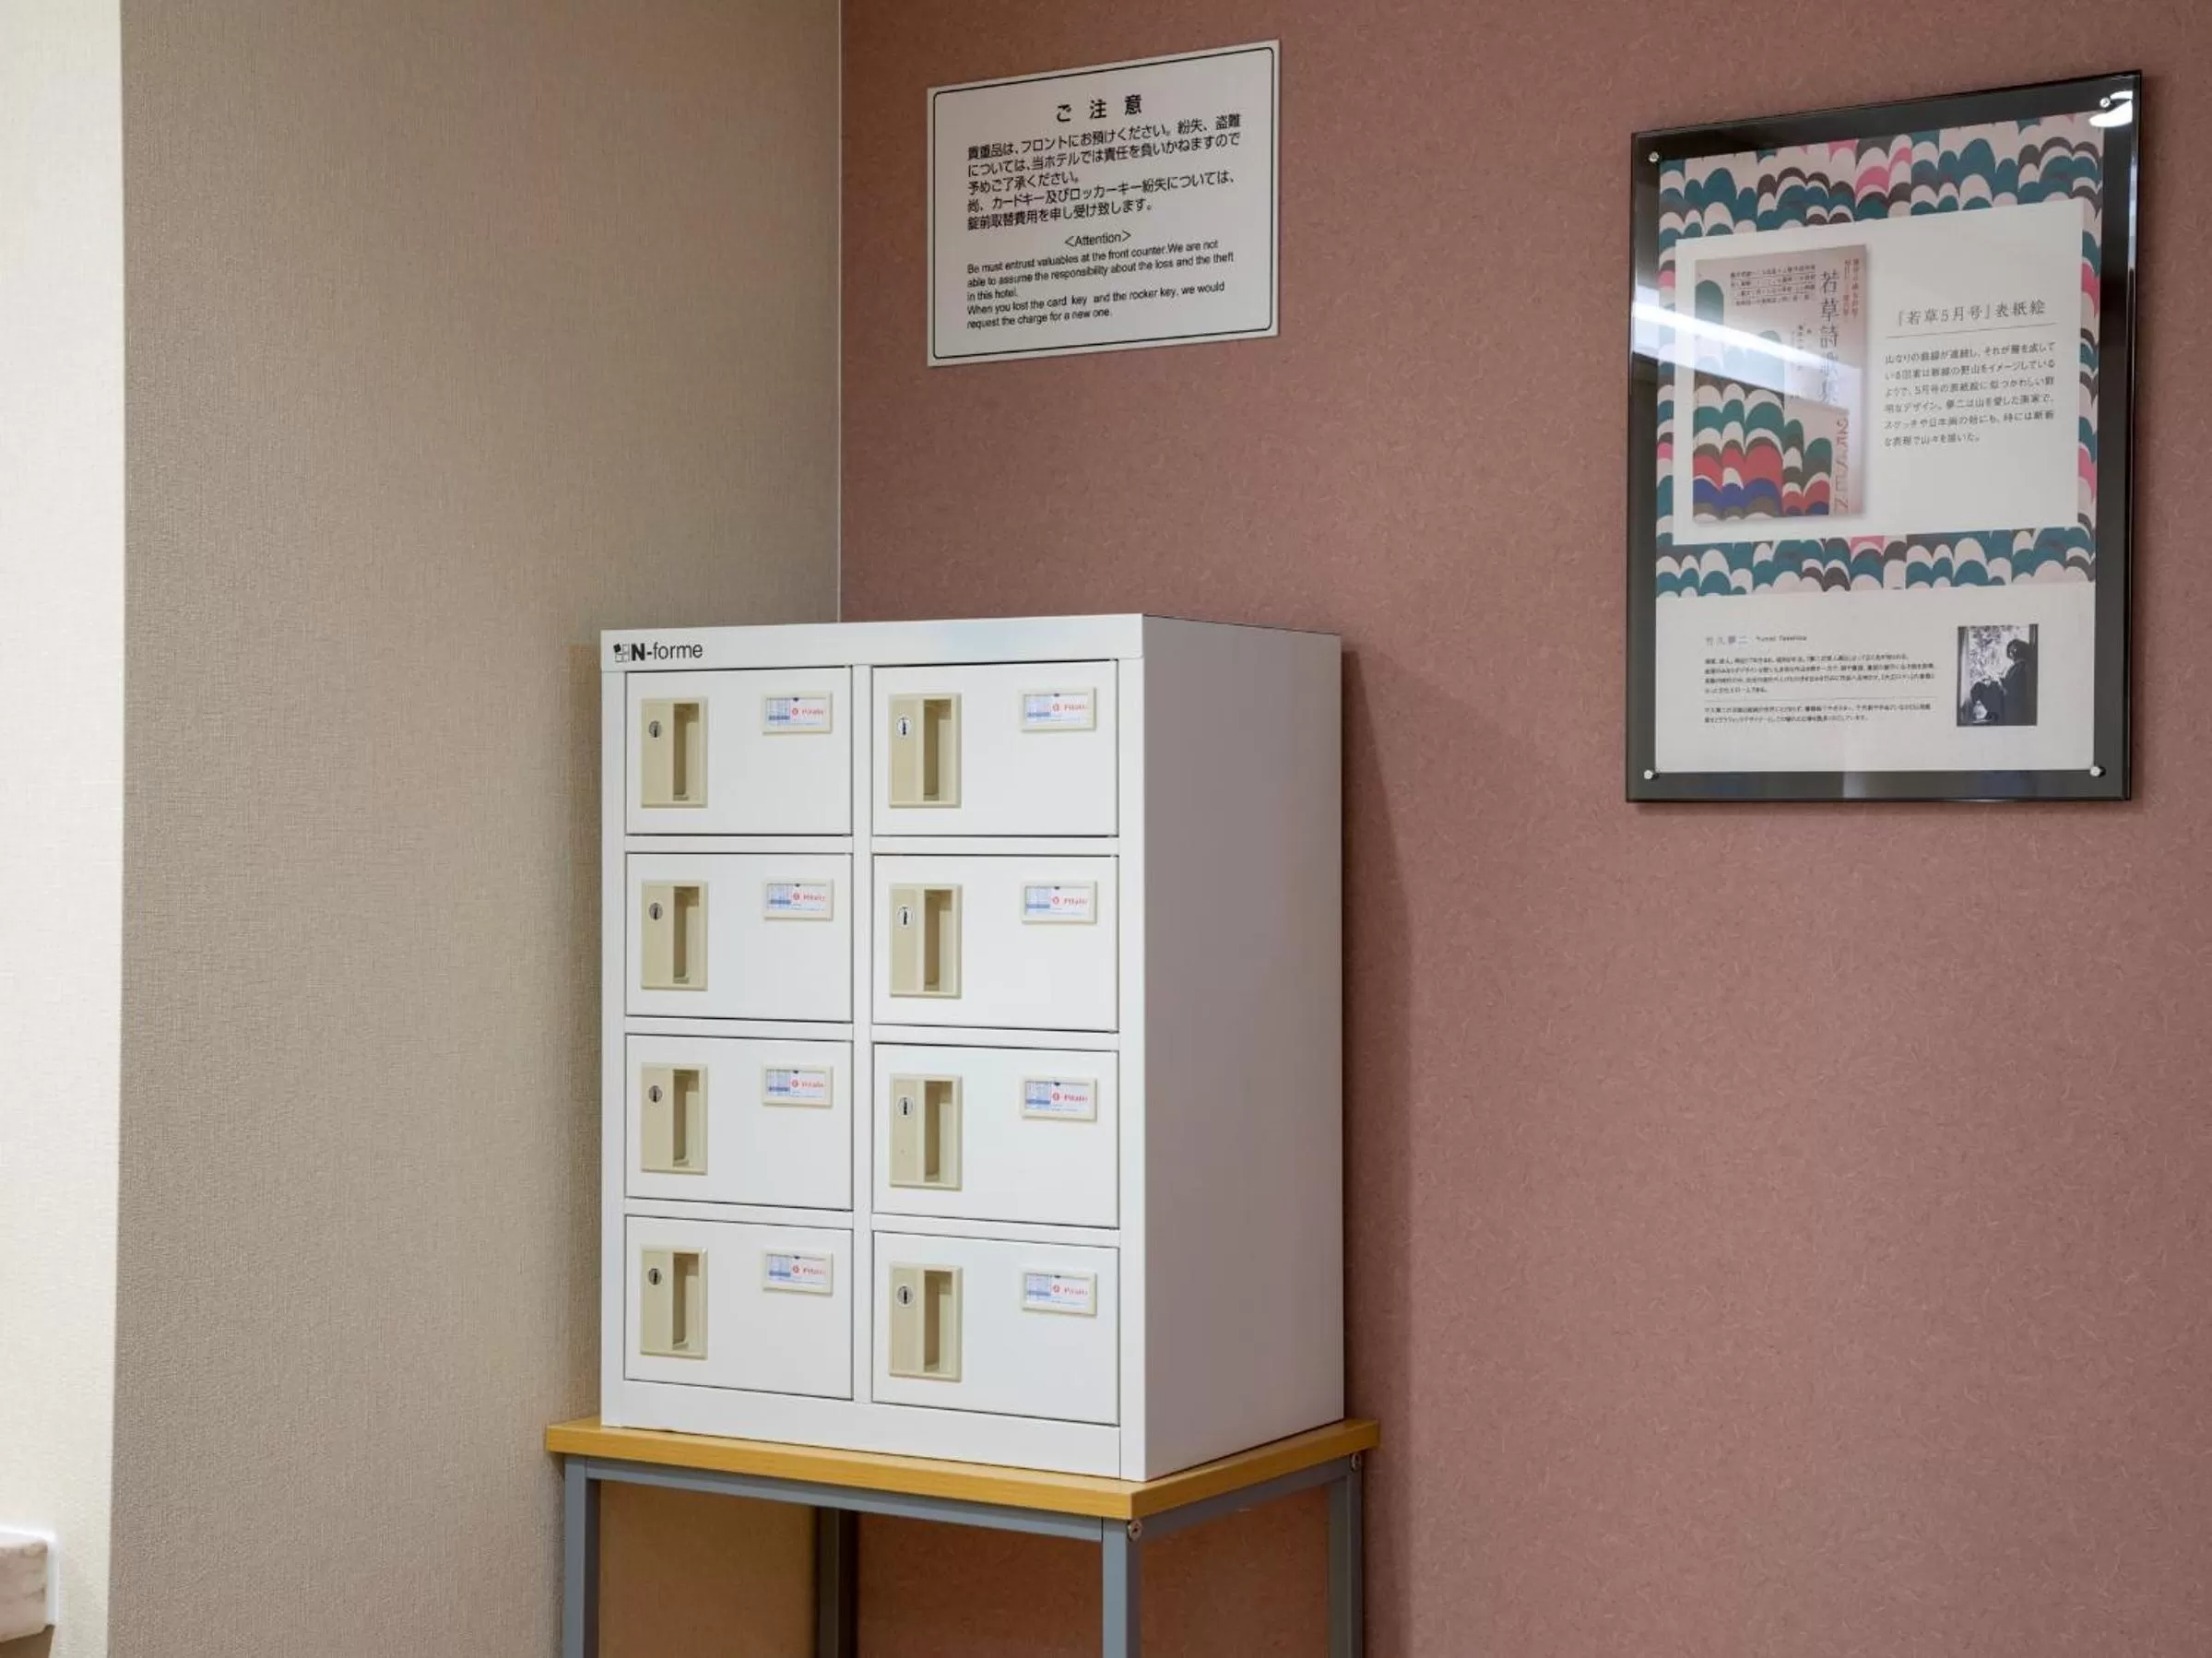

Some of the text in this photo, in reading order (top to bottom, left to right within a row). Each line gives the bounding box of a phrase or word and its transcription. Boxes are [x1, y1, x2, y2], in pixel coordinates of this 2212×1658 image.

[967, 264, 979, 274] Be
[982, 262, 1003, 272] must
[1005, 258, 1035, 270] entrust
[1036, 255, 1079, 266] valuables
[1081, 253, 1090, 262] at
[1092, 252, 1106, 261] the
[1108, 248, 1129, 259] front
[1186, 242, 1201, 251] are
[1203, 239, 1218, 250] not
[967, 278, 986, 288] able
[988, 277, 997, 286] to
[999, 274, 1033, 285] assume
[1035, 271, 1049, 280] the
[1051, 265, 1108, 280] responsibility
[1110, 262, 1137, 273] about
[1139, 261, 1153, 270] the
[1176, 256, 1194, 266] and
[1196, 255, 1211, 265] the
[1213, 251, 1234, 263] theft
[967, 292, 976, 302] in
[977, 290, 993, 301] this
[967, 304, 993, 314] When
[995, 303, 1011, 314] you
[1012, 300, 1029, 311] lost
[1031, 299, 1045, 309] the
[1047, 296, 1068, 307] card
[1071, 295, 1088, 306] key
[1094, 292, 1110, 302] and
[1113, 290, 1128, 301] the
[1130, 289, 1159, 300] rocker
[1181, 286, 1196, 295] we
[1197, 280, 1225, 292] would
[967, 317, 1000, 329] request
[1002, 315, 1016, 326] the
[1017, 313, 1048, 325] charge
[1050, 311, 1062, 321] for
[1071, 309, 1091, 319] new
[631, 642, 703, 661] N-forme
